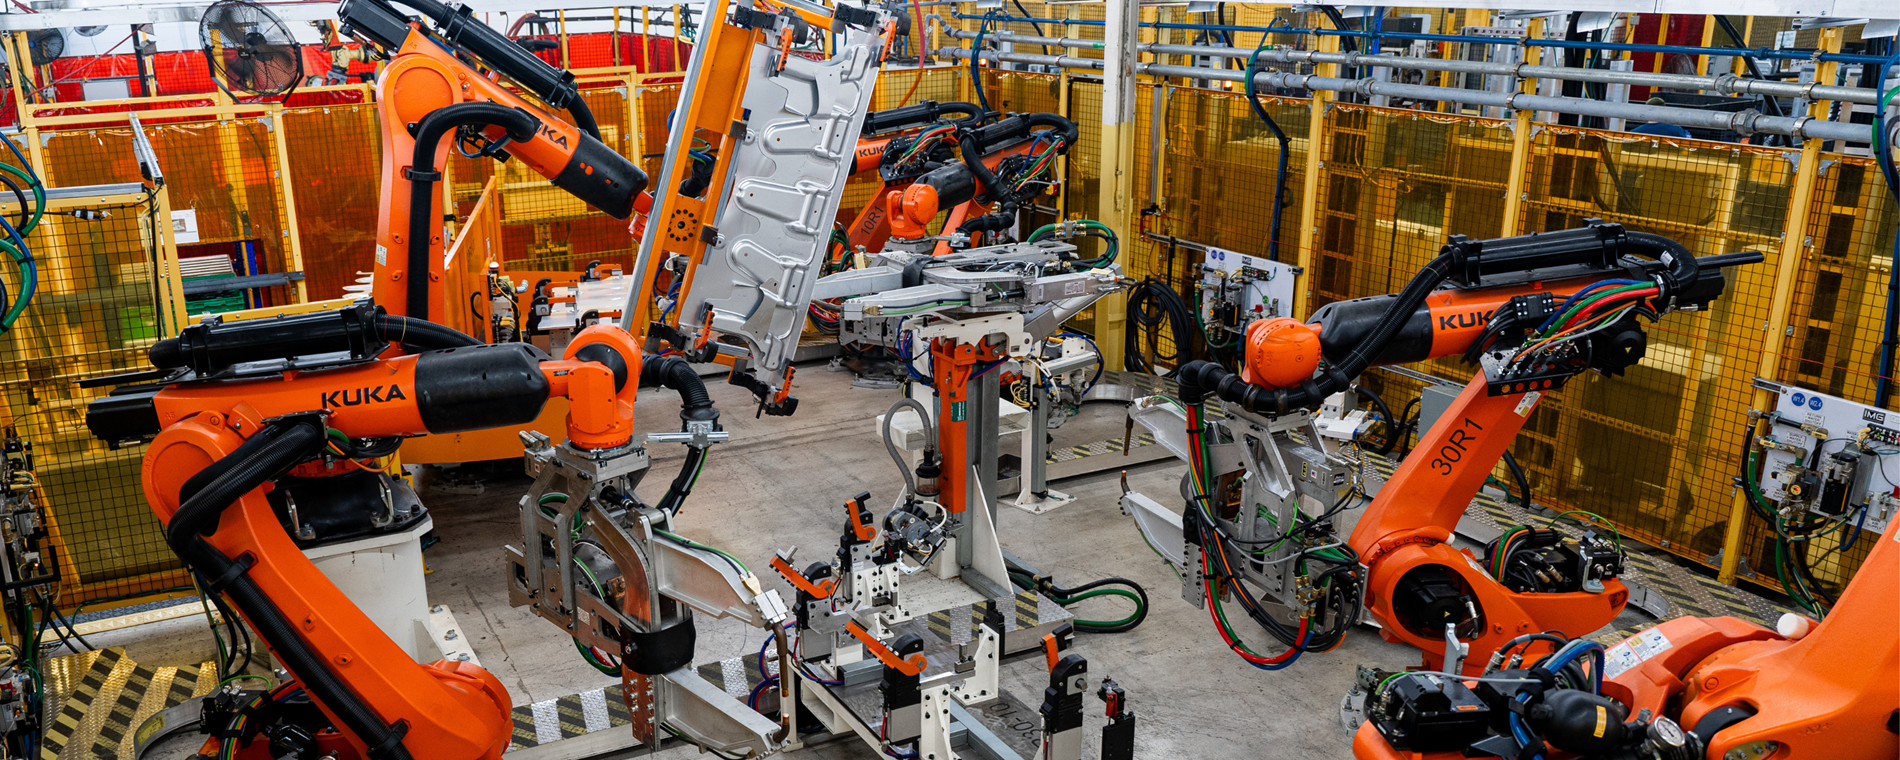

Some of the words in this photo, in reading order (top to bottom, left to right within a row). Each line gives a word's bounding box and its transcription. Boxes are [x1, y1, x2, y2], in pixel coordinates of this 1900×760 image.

[541, 124, 568, 150] KA
[859, 145, 884, 157] KUK
[860, 205, 884, 235] 10R1
[1439, 310, 1493, 330] KUK
[321, 384, 406, 409] KUKA
[1791, 395, 1805, 404] W1.4
[1864, 409, 1884, 422] IMG
[1431, 417, 1483, 476] 30R1
